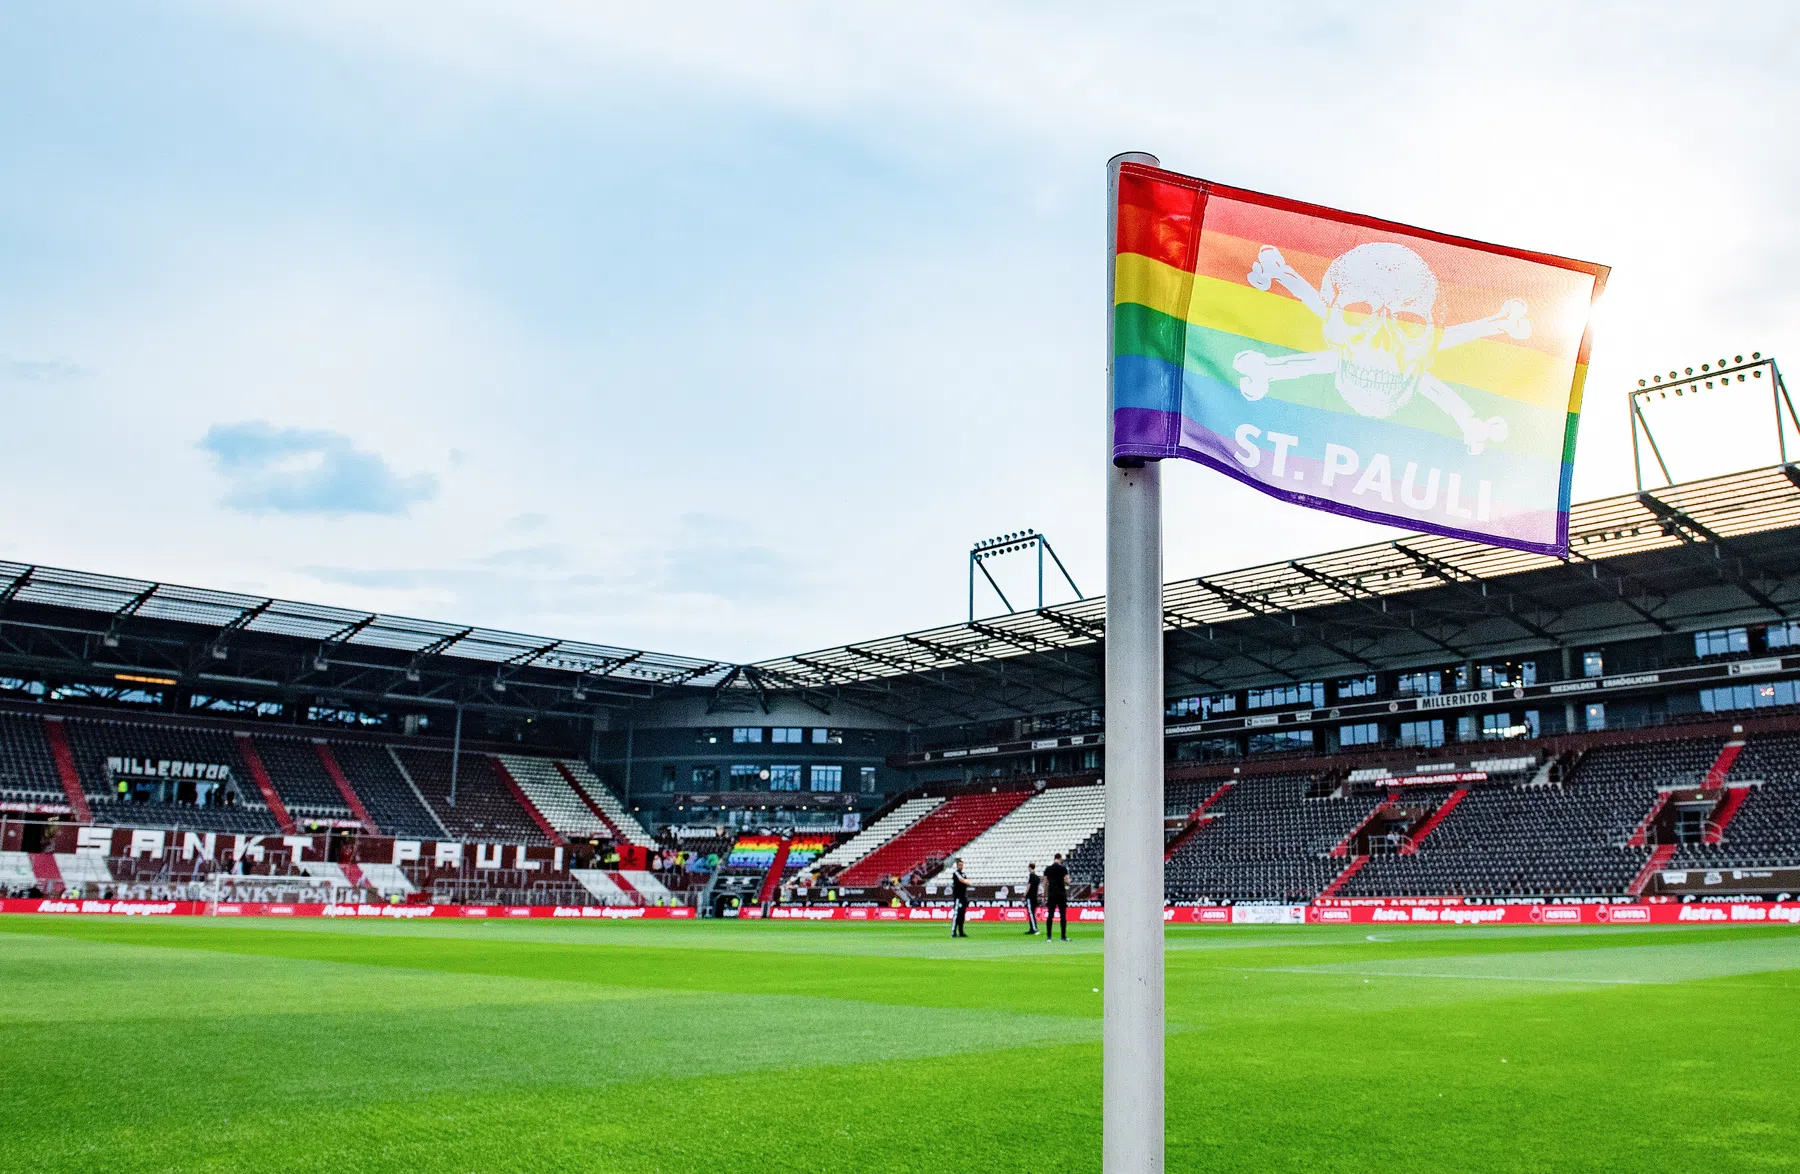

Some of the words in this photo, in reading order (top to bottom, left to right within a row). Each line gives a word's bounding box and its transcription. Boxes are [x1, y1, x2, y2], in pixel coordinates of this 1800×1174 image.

[1234, 423, 1304, 480] ST.
[1322, 442, 1493, 523] PAULI
[1421, 691, 1488, 709] MILLERNTOR
[107, 757, 230, 780] MILLERNTOR
[76, 827, 313, 864] SANKT
[392, 840, 563, 870] PAULI
[1372, 908, 1409, 921] Astra.
[1678, 905, 1728, 921] Astra.
[1731, 904, 1766, 920] Was
